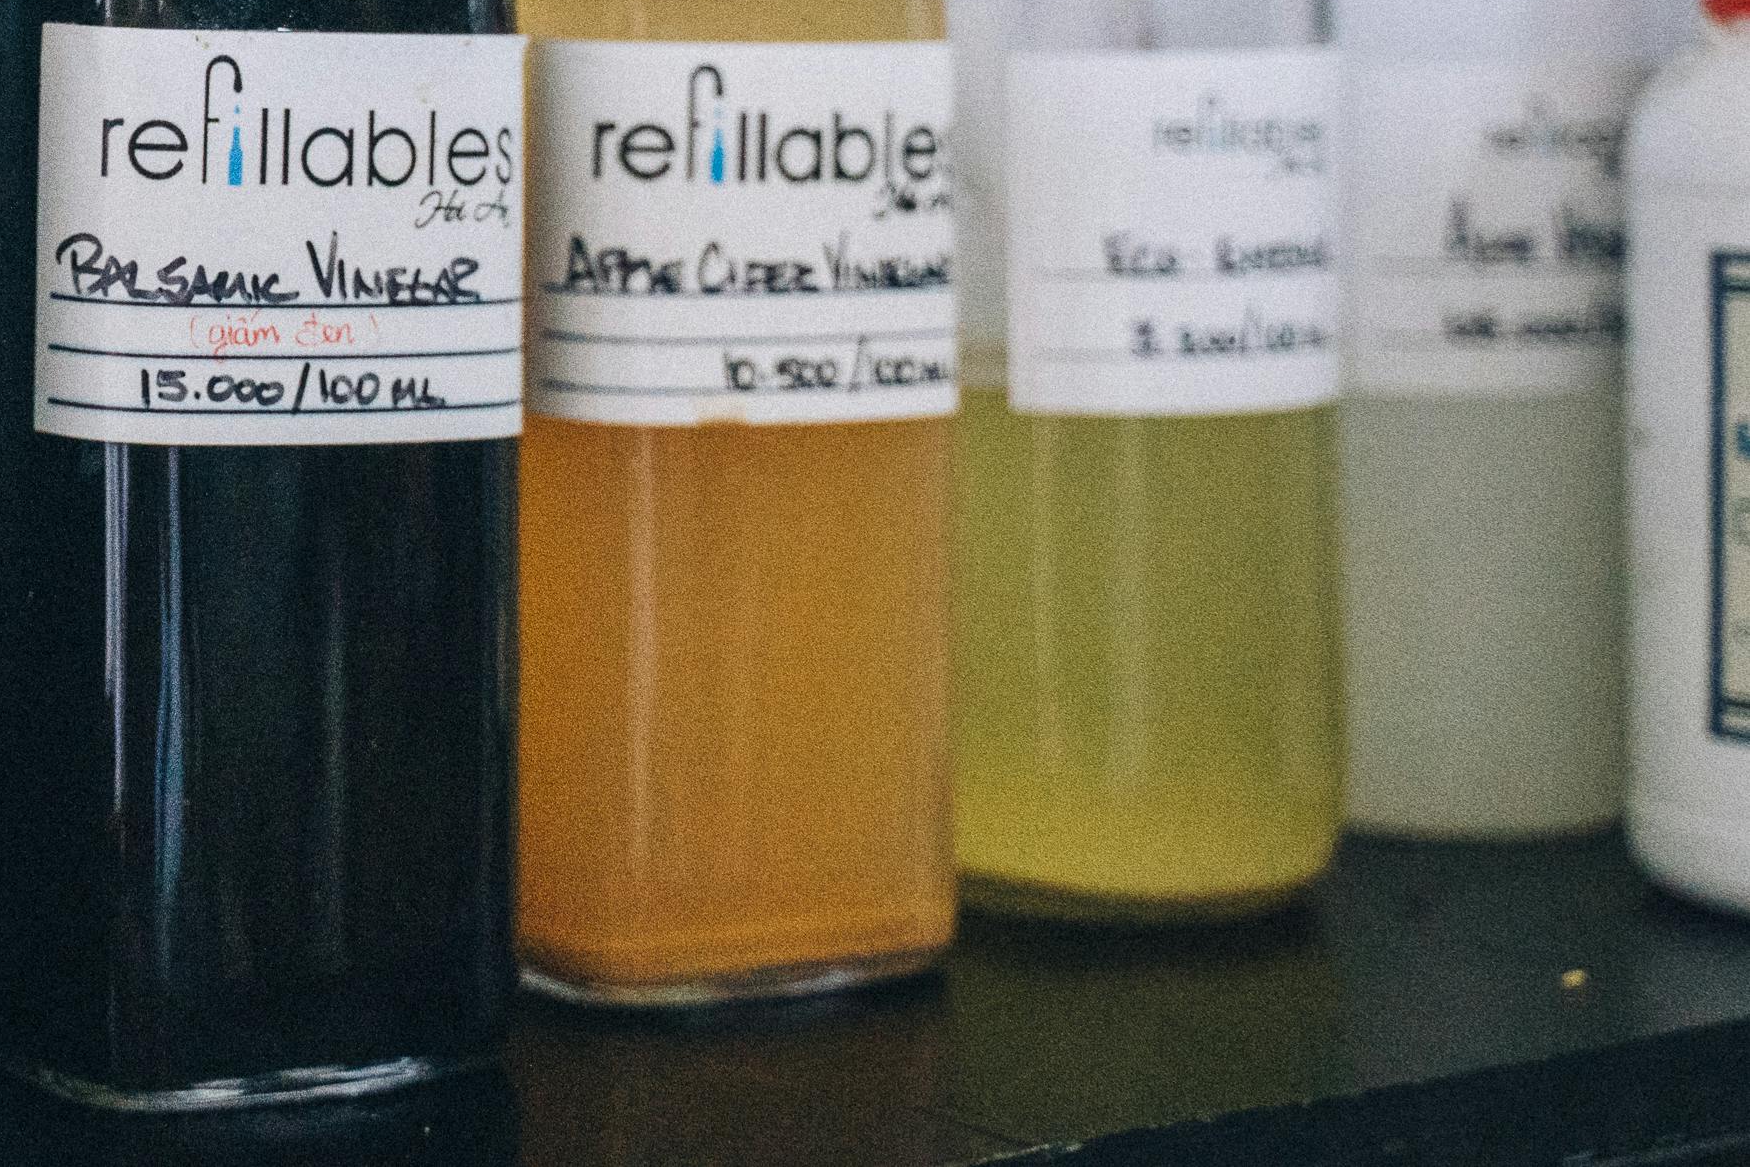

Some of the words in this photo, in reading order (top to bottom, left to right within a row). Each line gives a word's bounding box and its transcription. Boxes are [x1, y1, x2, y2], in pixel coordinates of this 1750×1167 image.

[100, 55, 512, 186] refillables
[593, 64, 950, 185] refillable
[56, 232, 299, 304] BALSAMIC
[306, 231, 482, 304] VINEGAR
